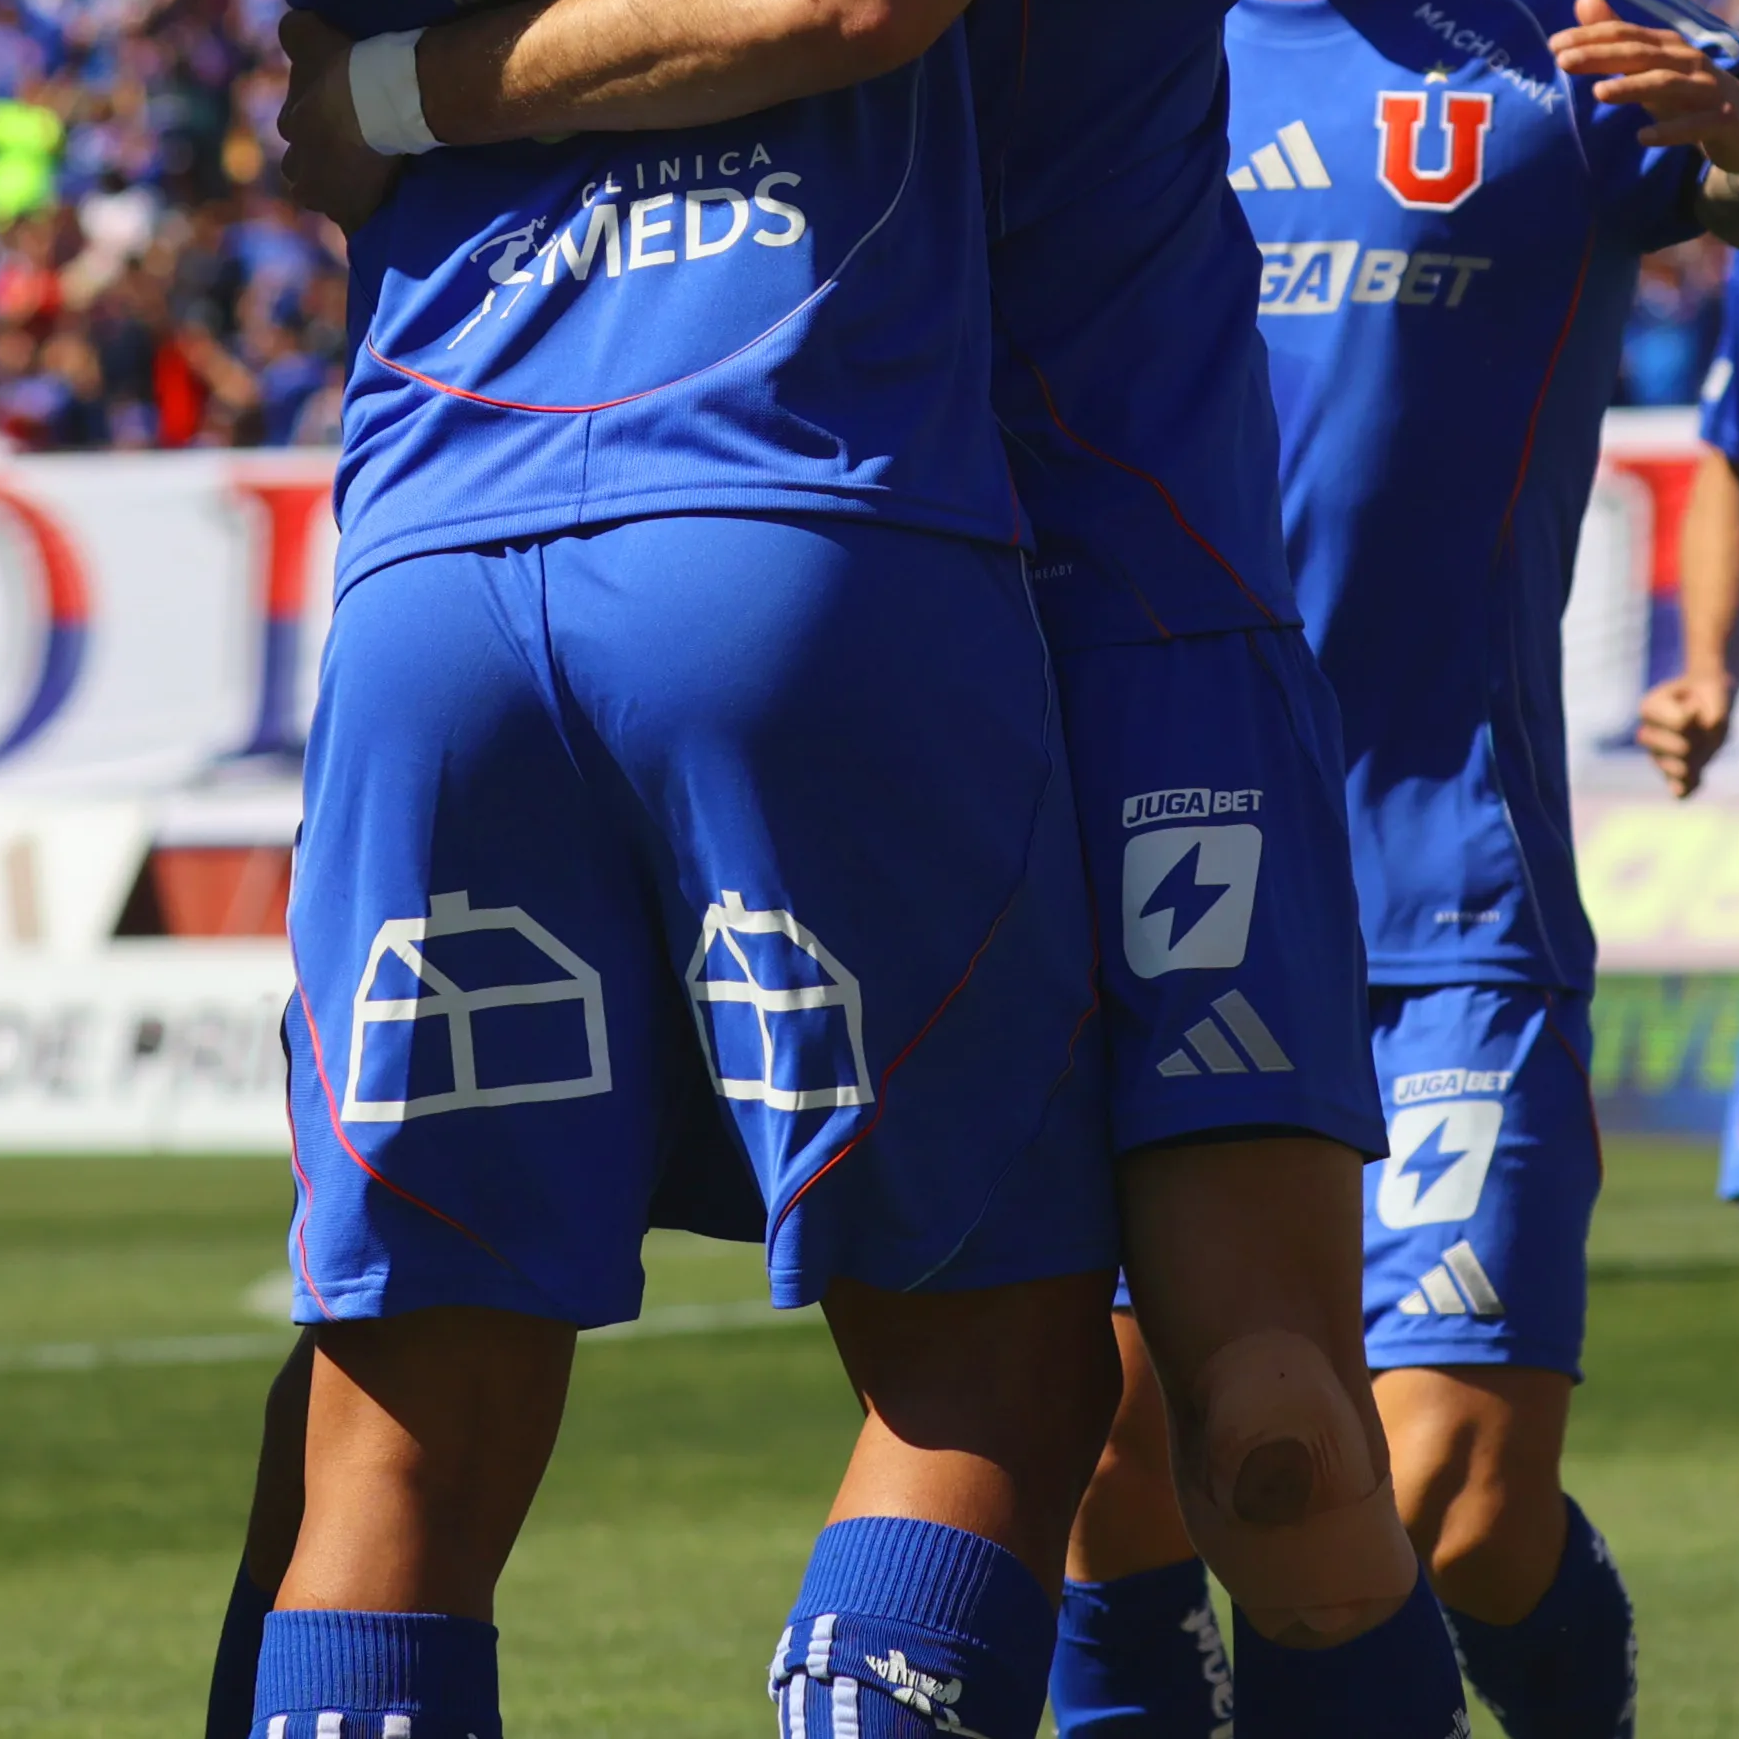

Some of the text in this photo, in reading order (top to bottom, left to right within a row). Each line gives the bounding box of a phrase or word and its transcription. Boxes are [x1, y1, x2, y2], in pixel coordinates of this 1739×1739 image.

[1414, 2, 1565, 114] MACHBANK
[581, 142, 773, 208] CLINICA
[1375, 90, 1492, 213] U
[541, 171, 807, 284] MEDS
[1259, 250, 1492, 307] GABET
[1035, 562, 1073, 579] READY
